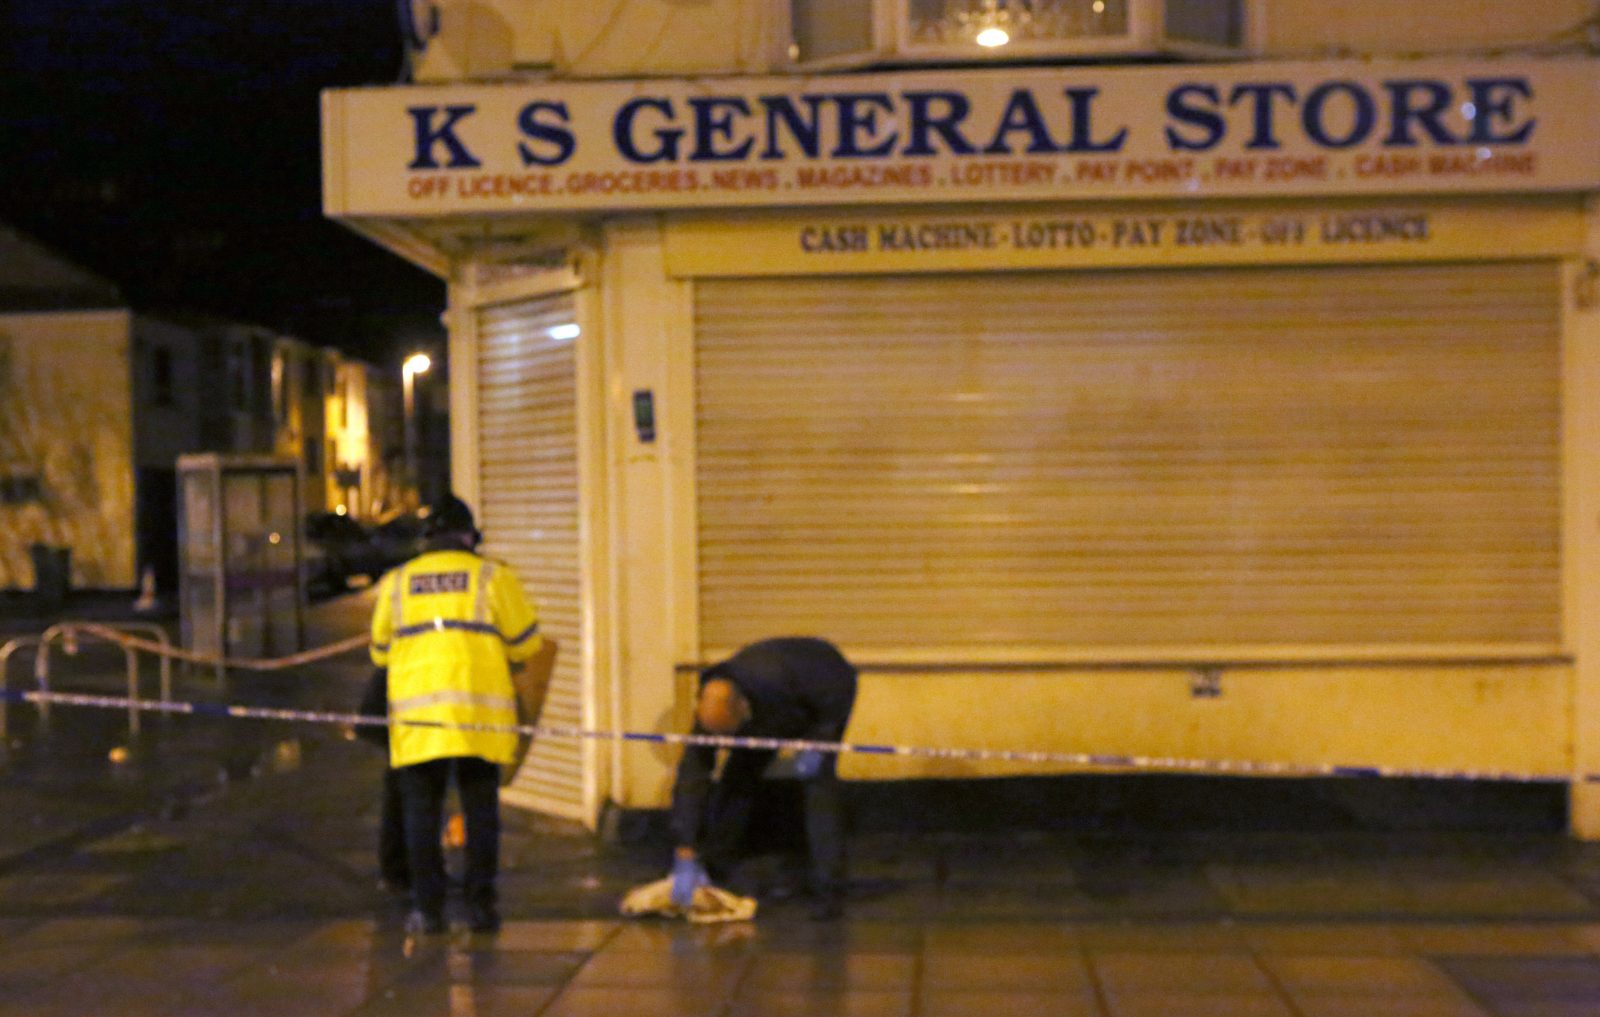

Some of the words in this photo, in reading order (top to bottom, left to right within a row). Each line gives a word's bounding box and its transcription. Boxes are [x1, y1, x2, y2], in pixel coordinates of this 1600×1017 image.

[407, 105, 480, 169] K
[517, 101, 576, 167] S
[613, 87, 1127, 164] GENERAL
[1165, 77, 1536, 151] STORE
[408, 175, 450, 199] OFF
[951, 160, 1056, 185] LOTTERY
[1075, 158, 1121, 181] PAY
[800, 224, 869, 252] CASH
[876, 222, 993, 250] MACHINE
[1012, 220, 1096, 248] LOTTO
[1112, 218, 1163, 248] PAY
[411, 573, 468, 594] POLICE
